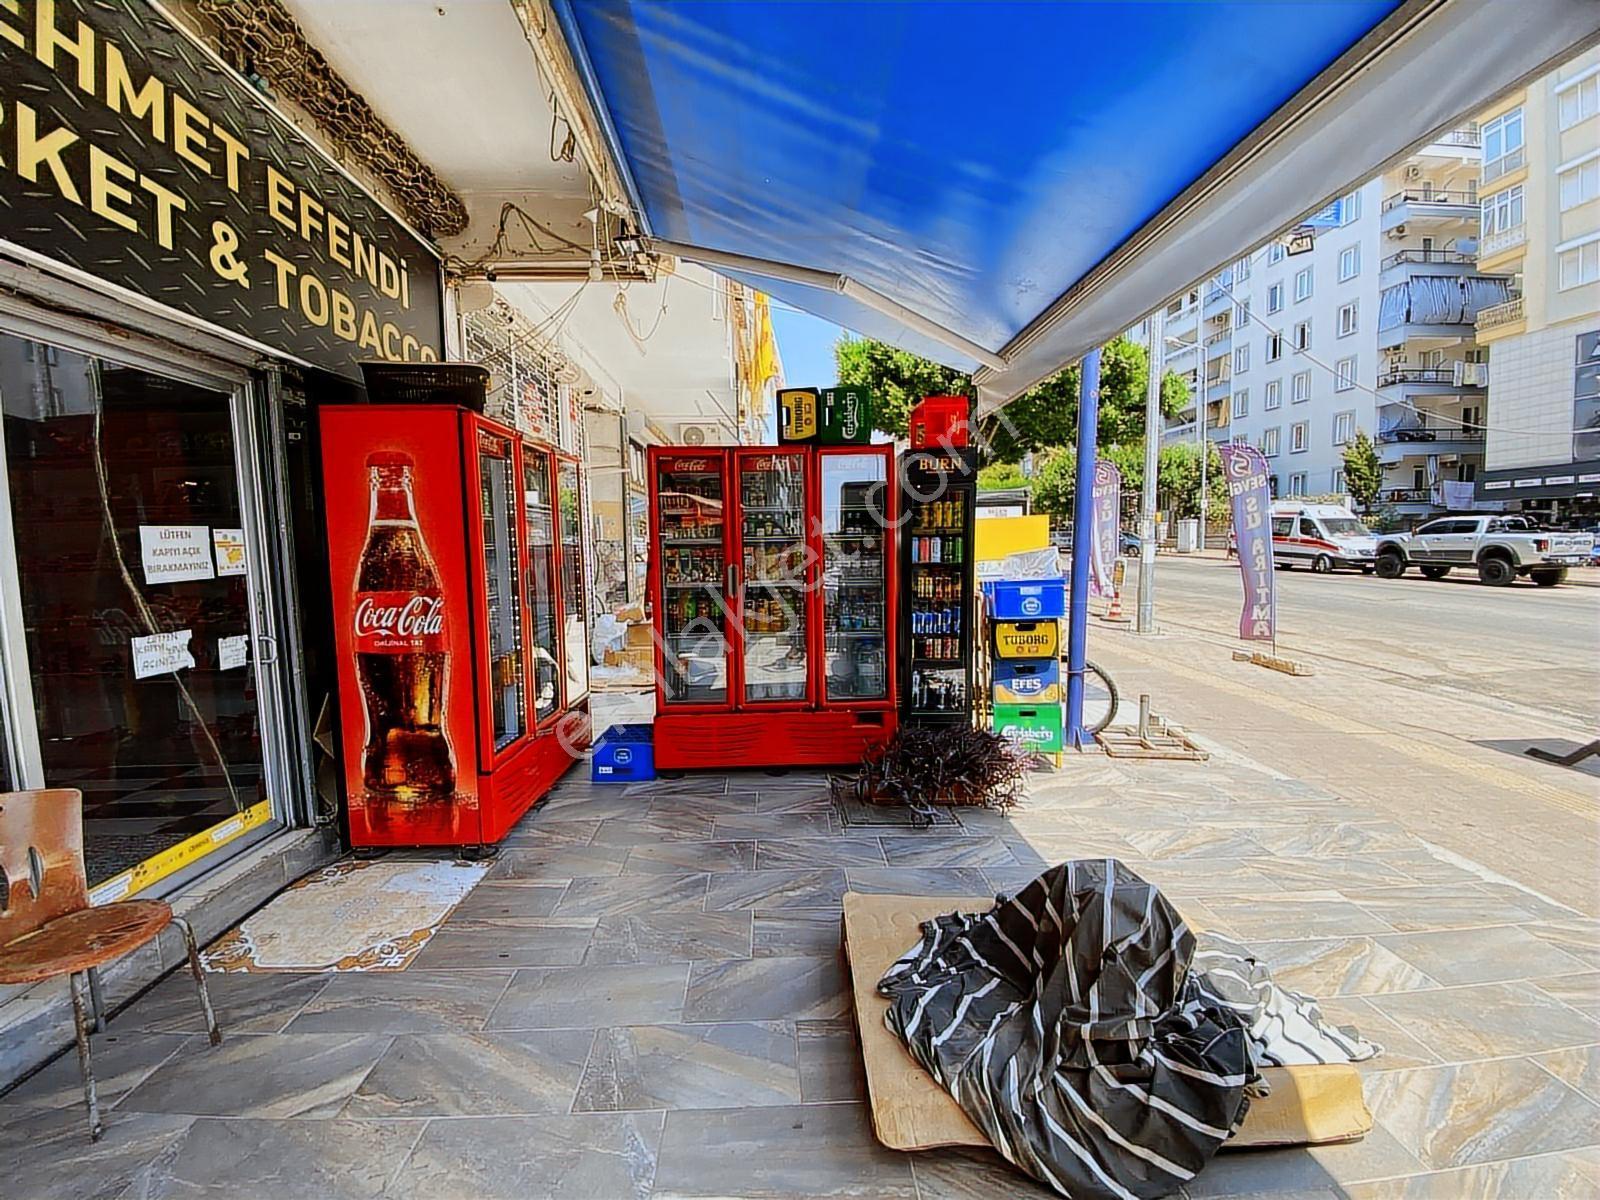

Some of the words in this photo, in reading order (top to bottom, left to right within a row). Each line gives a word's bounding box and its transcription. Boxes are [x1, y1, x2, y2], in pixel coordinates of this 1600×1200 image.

[0, 100, 186, 250] KET
[209, 220, 250, 290] &
[267, 165, 409, 309] EFENDİ
[920, 457, 962, 470] BURN
[160, 529, 191, 540] LÜTFEN
[355, 596, 443, 636] Coca-Cola
[1003, 634, 1049, 645] TUBORG
[1012, 678, 1042, 690] EFES
